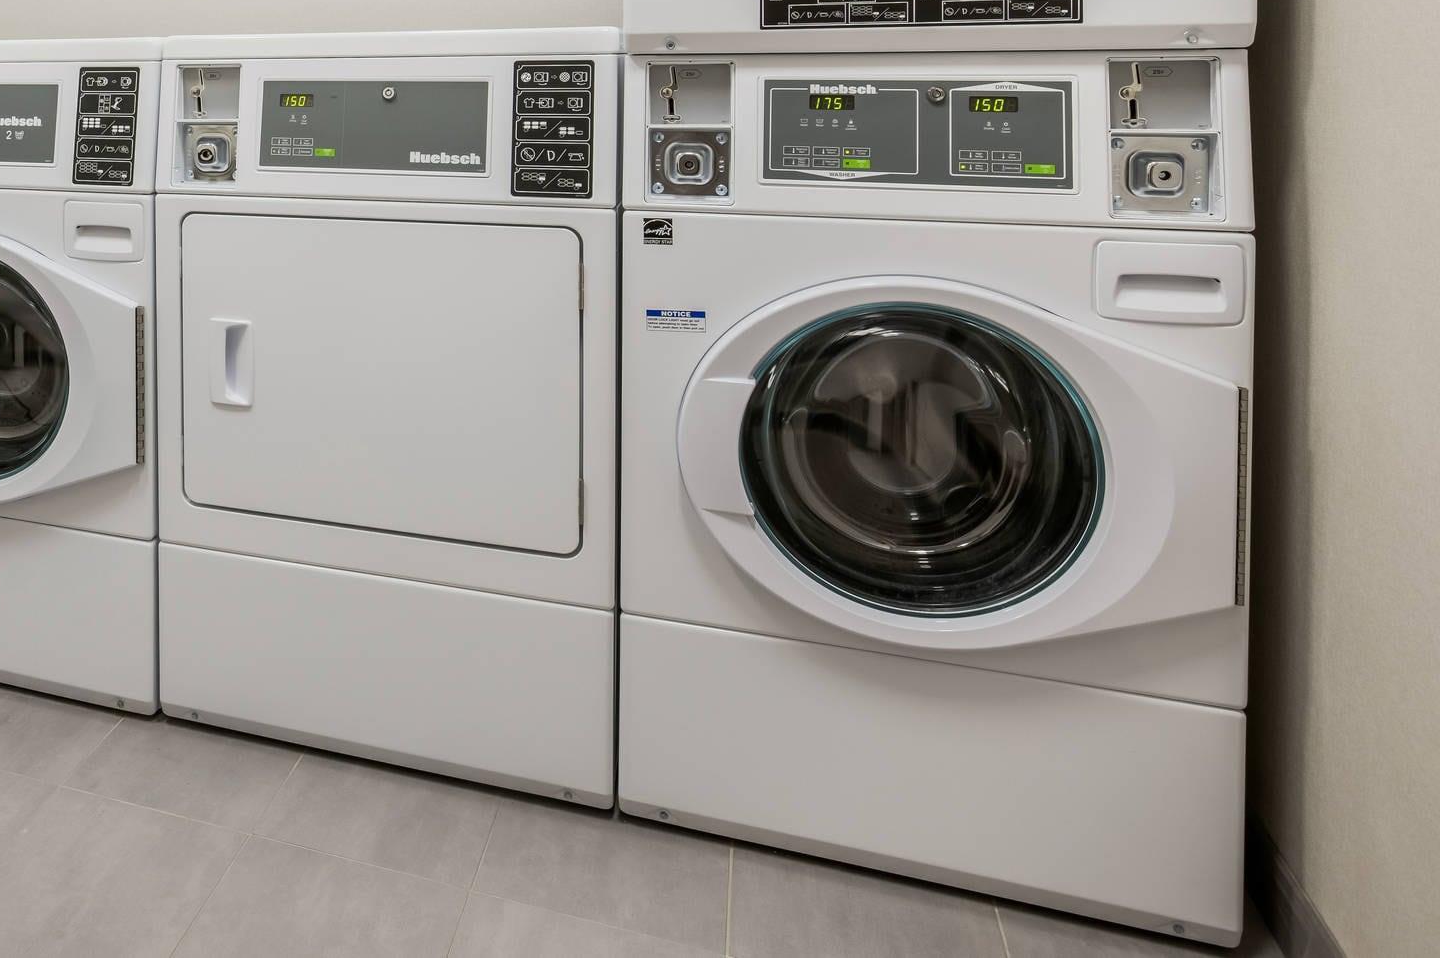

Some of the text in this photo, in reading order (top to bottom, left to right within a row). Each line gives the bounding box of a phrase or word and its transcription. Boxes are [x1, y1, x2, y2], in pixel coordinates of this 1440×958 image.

[810, 84, 876, 95] Huebsch
[285, 95, 306, 107] 150
[815, 97, 842, 110] 175
[974, 98, 1004, 112] 150
[5, 130, 12, 140] 2
[410, 151, 481, 165] Huebsch
